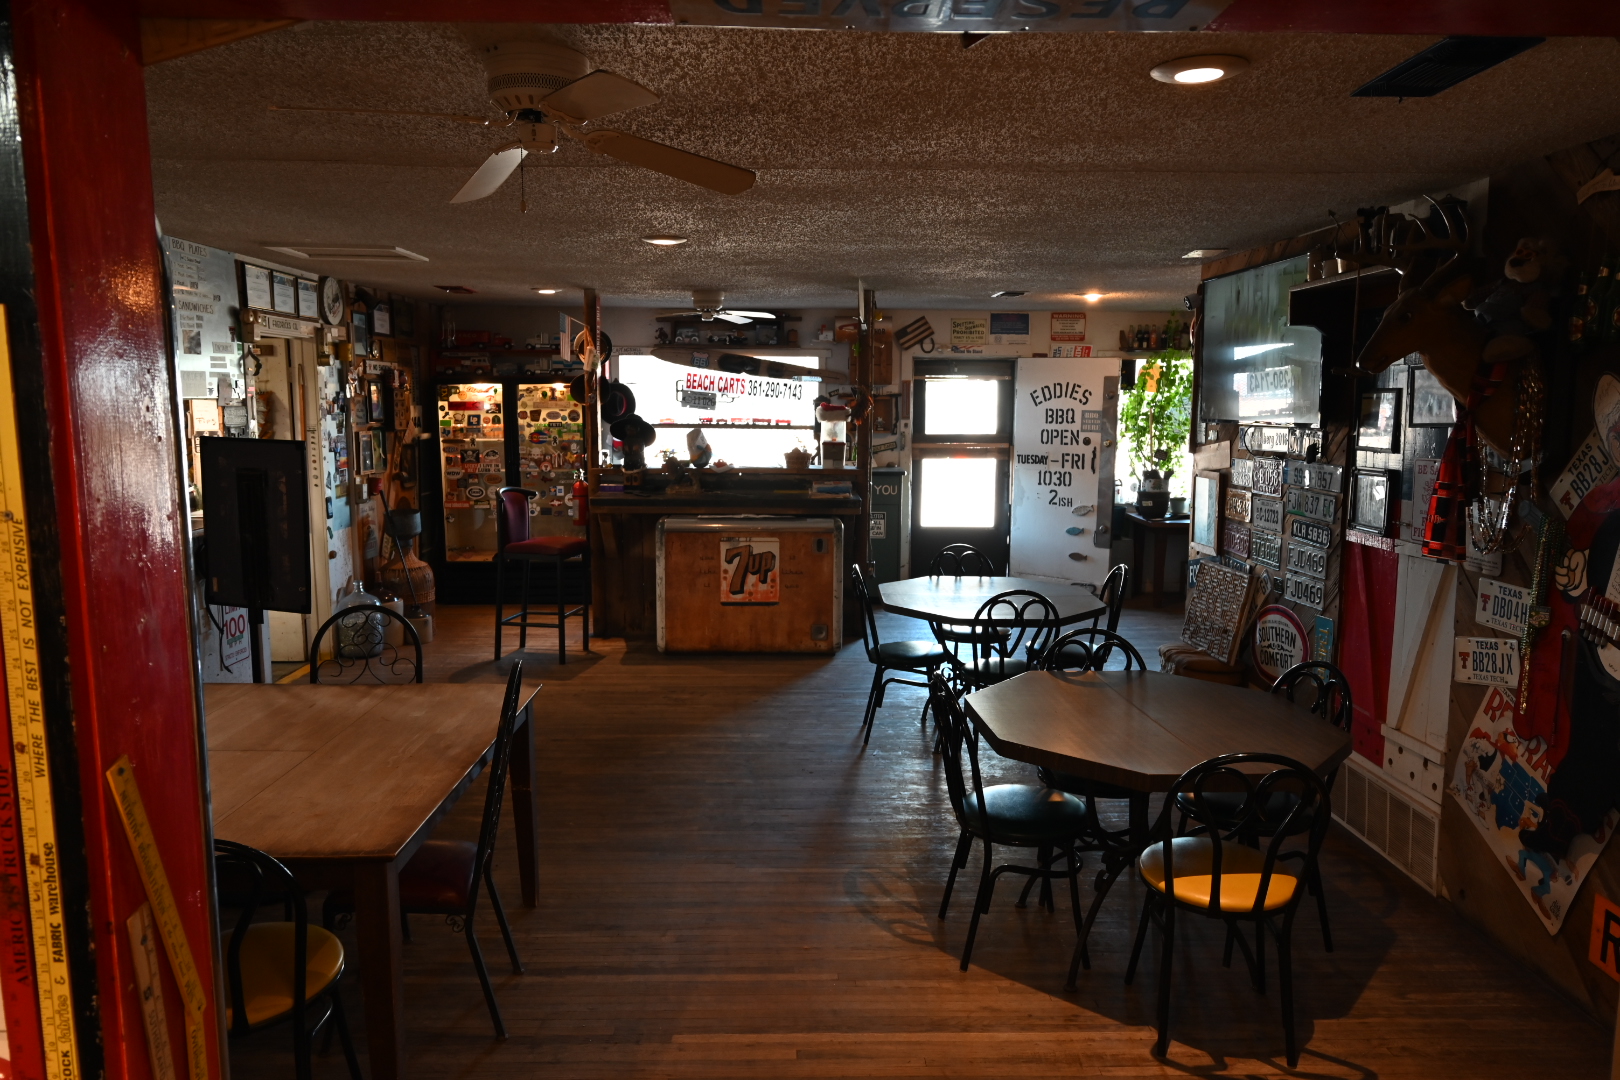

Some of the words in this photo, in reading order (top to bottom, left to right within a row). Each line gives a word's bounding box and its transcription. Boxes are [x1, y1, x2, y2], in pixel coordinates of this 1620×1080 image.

[188, 243, 208, 257] PLATES
[178, 300, 214, 314] SANDWICHES
[694, 357, 709, 367] 66
[686, 373, 715, 391] BEACH
[717, 377, 746, 394] CARTS
[747, 380, 803, 400] 361-290-7143
[1030, 382, 1092, 407] EDDIES
[1045, 408, 1076, 424] BBQ
[1040, 429, 1080, 446] OPEN
[1017, 454, 1049, 465] TUESDAY
[1061, 453, 1085, 470] FRI
[1568, 443, 1593, 476] TEXAS
[1037, 470, 1072, 487] 1030
[1293, 467, 1333, 490] 99--1857
[1418, 465, 1427, 475] BE
[1430, 465, 1441, 476] SA
[1599, 464, 1615, 485] TECH
[874, 484, 898, 495] YOU
[1304, 495, 1320, 515] 837
[1413, 526, 1426, 537] FIG
[12, 518, 30, 591] EXPENSIVE
[1287, 544, 1326, 574] FJD469
[1285, 576, 1323, 606] FJD469
[1498, 585, 1523, 600] TEXAS
[19, 598, 33, 629] NOT
[223, 614, 246, 640] 100
[1491, 618, 1508, 628] TEXAS
[23, 637, 35, 650] IS
[1258, 627, 1297, 650] SOUTHERN
[1475, 640, 1499, 651] TEXAS
[1259, 649, 1294, 670] COMFORT
[1473, 651, 1514, 675] BB28JX
[24, 659, 39, 691] BEST
[1473, 673, 1488, 681] TEXAS
[1490, 675, 1505, 683] TECH
[28, 699, 41, 724] THE
[17, 714, 26, 727] 22
[31, 733, 46, 779] WHERE
[23, 770, 32, 783] 20
[0, 764, 14, 811] STOP
[26, 799, 35, 811] 19
[28, 826, 37, 839] 18
[1, 817, 17, 878] TRUCK
[119, 790, 141, 842] NUTRITIVE
[137, 844, 166, 917] REHABILITATION
[43, 841, 60, 917] warehouse
[35, 908, 44, 920] 15
[37, 935, 46, 947] 14
[50, 922, 65, 963] FABRIC
[40, 962, 49, 975] 13
[54, 975, 66, 985] &
[42, 989, 52, 1001] 12
[45, 1016, 55, 1026] 11
[48, 1040, 57, 1053] 10
[149, 1010, 166, 1080] SUTHERLAND
